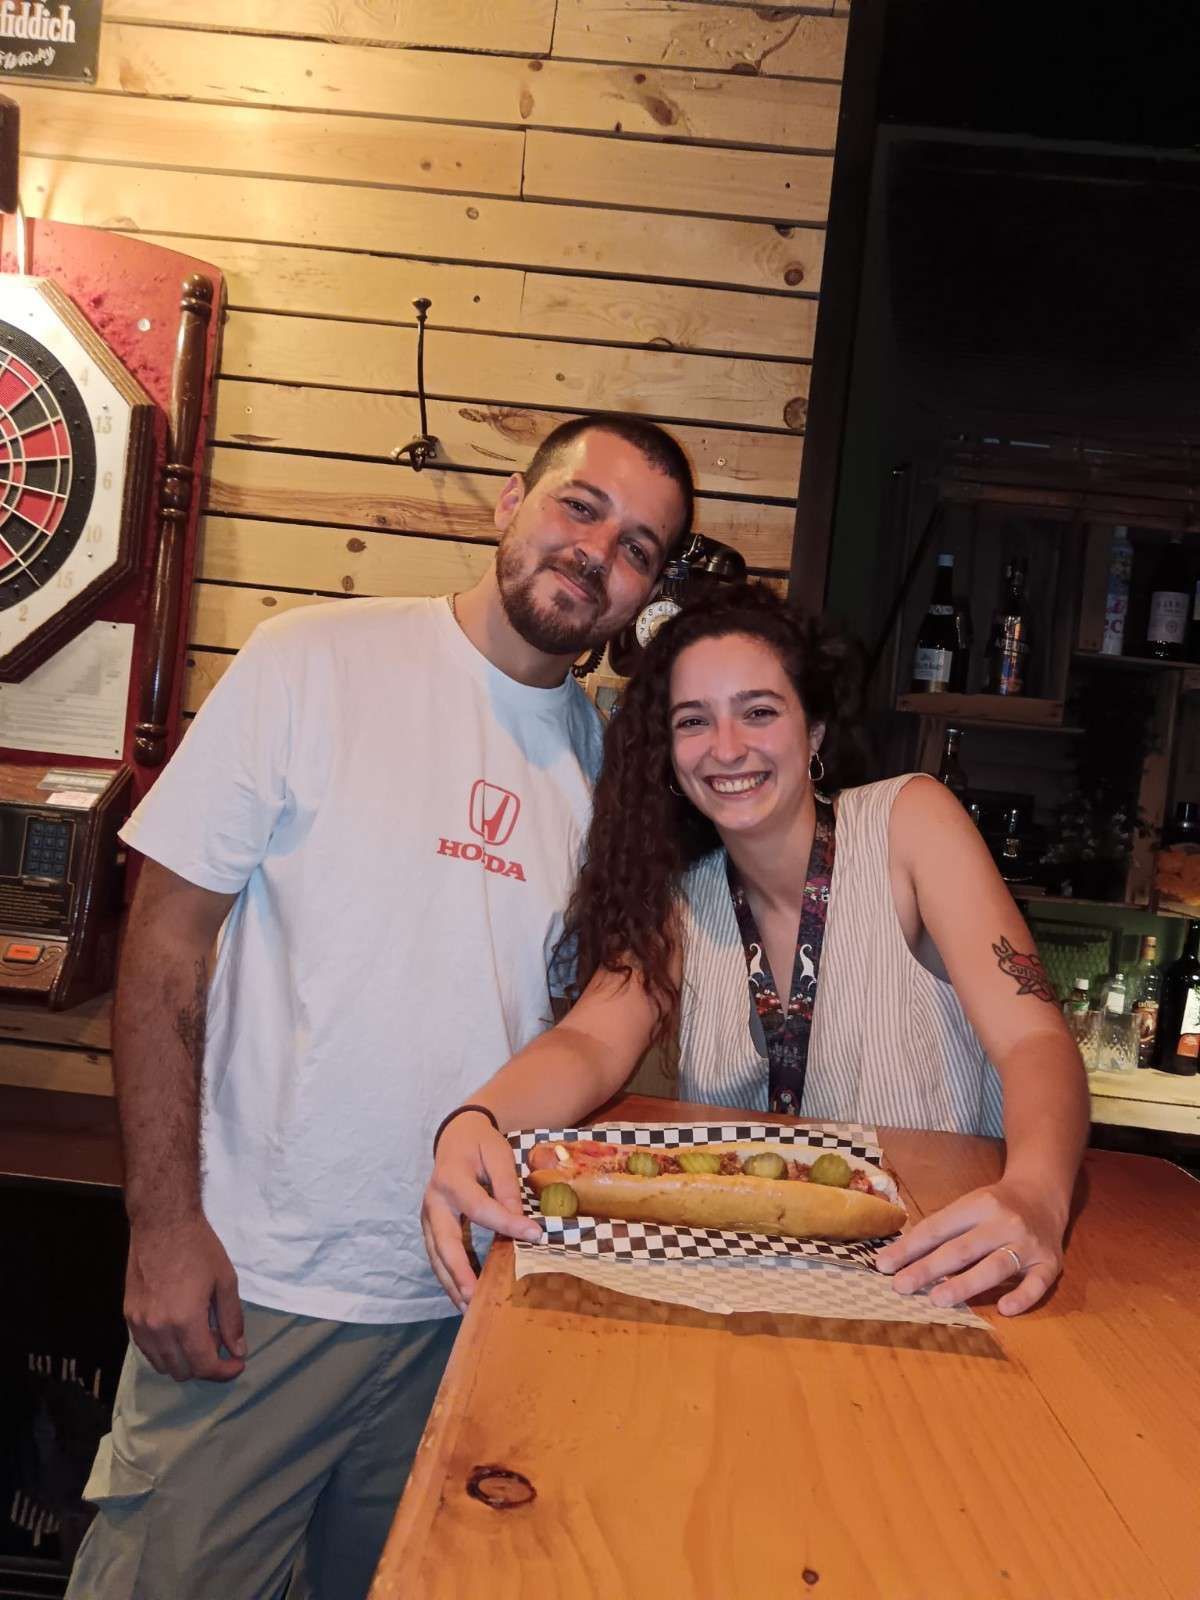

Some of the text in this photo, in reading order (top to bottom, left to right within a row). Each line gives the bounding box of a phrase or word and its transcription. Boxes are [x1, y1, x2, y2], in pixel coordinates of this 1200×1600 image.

[95, 414, 112, 434] 13
[102, 470, 112, 491] 6
[86, 525, 102, 544] 10
[57, 570, 73, 589] 15
[18, 603, 29, 622] 2
[436, 837, 528, 882] HODA
